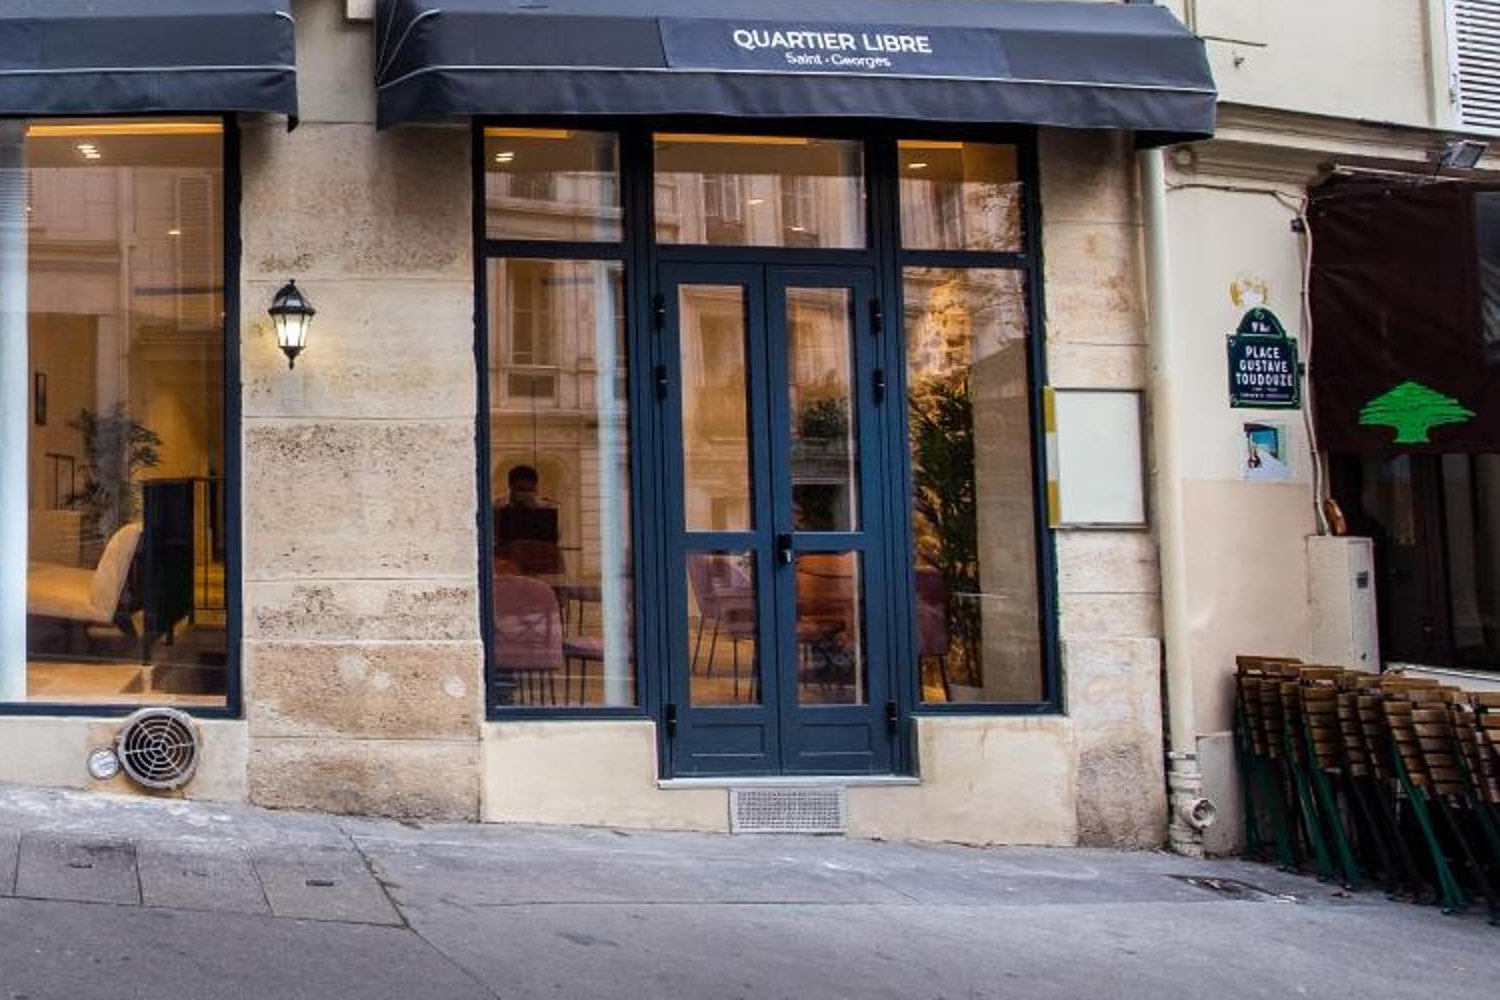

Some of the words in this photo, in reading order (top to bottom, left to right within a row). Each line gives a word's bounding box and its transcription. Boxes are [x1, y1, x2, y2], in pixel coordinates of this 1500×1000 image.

[732, 29, 855, 51] QUARTIER
[863, 34, 933, 54] LIBRE
[1245, 345, 1281, 359] PLACE
[1239, 359, 1289, 373] GUSTAVE
[1235, 372, 1293, 387] TOUDOUZE
